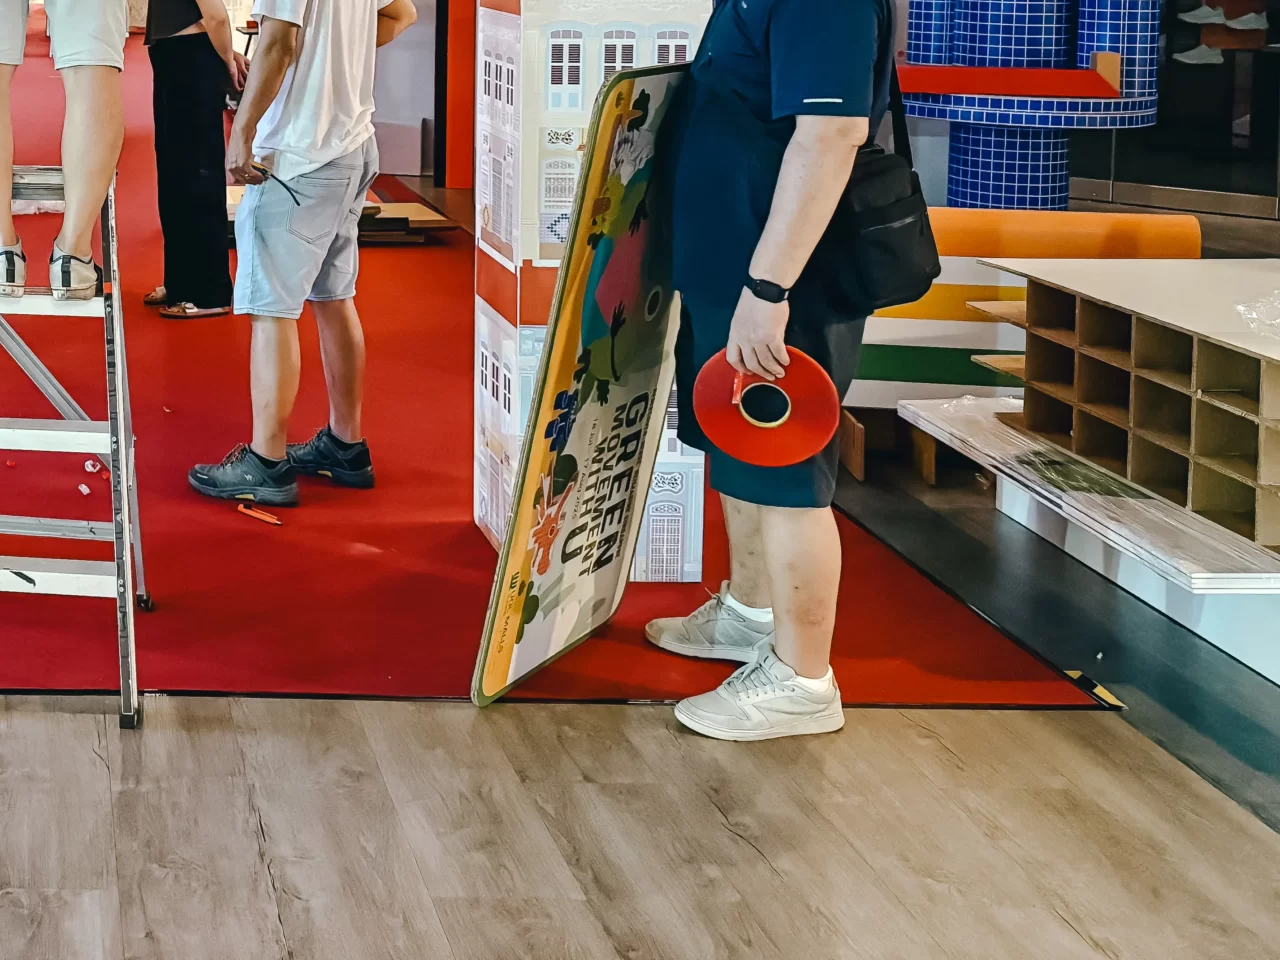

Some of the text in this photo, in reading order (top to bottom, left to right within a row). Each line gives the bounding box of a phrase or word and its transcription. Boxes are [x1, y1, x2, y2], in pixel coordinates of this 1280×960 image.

[560, 435, 609, 565] WITH U
[578, 402, 628, 578] MOVEMENT
[591, 391, 650, 576] GREEN
